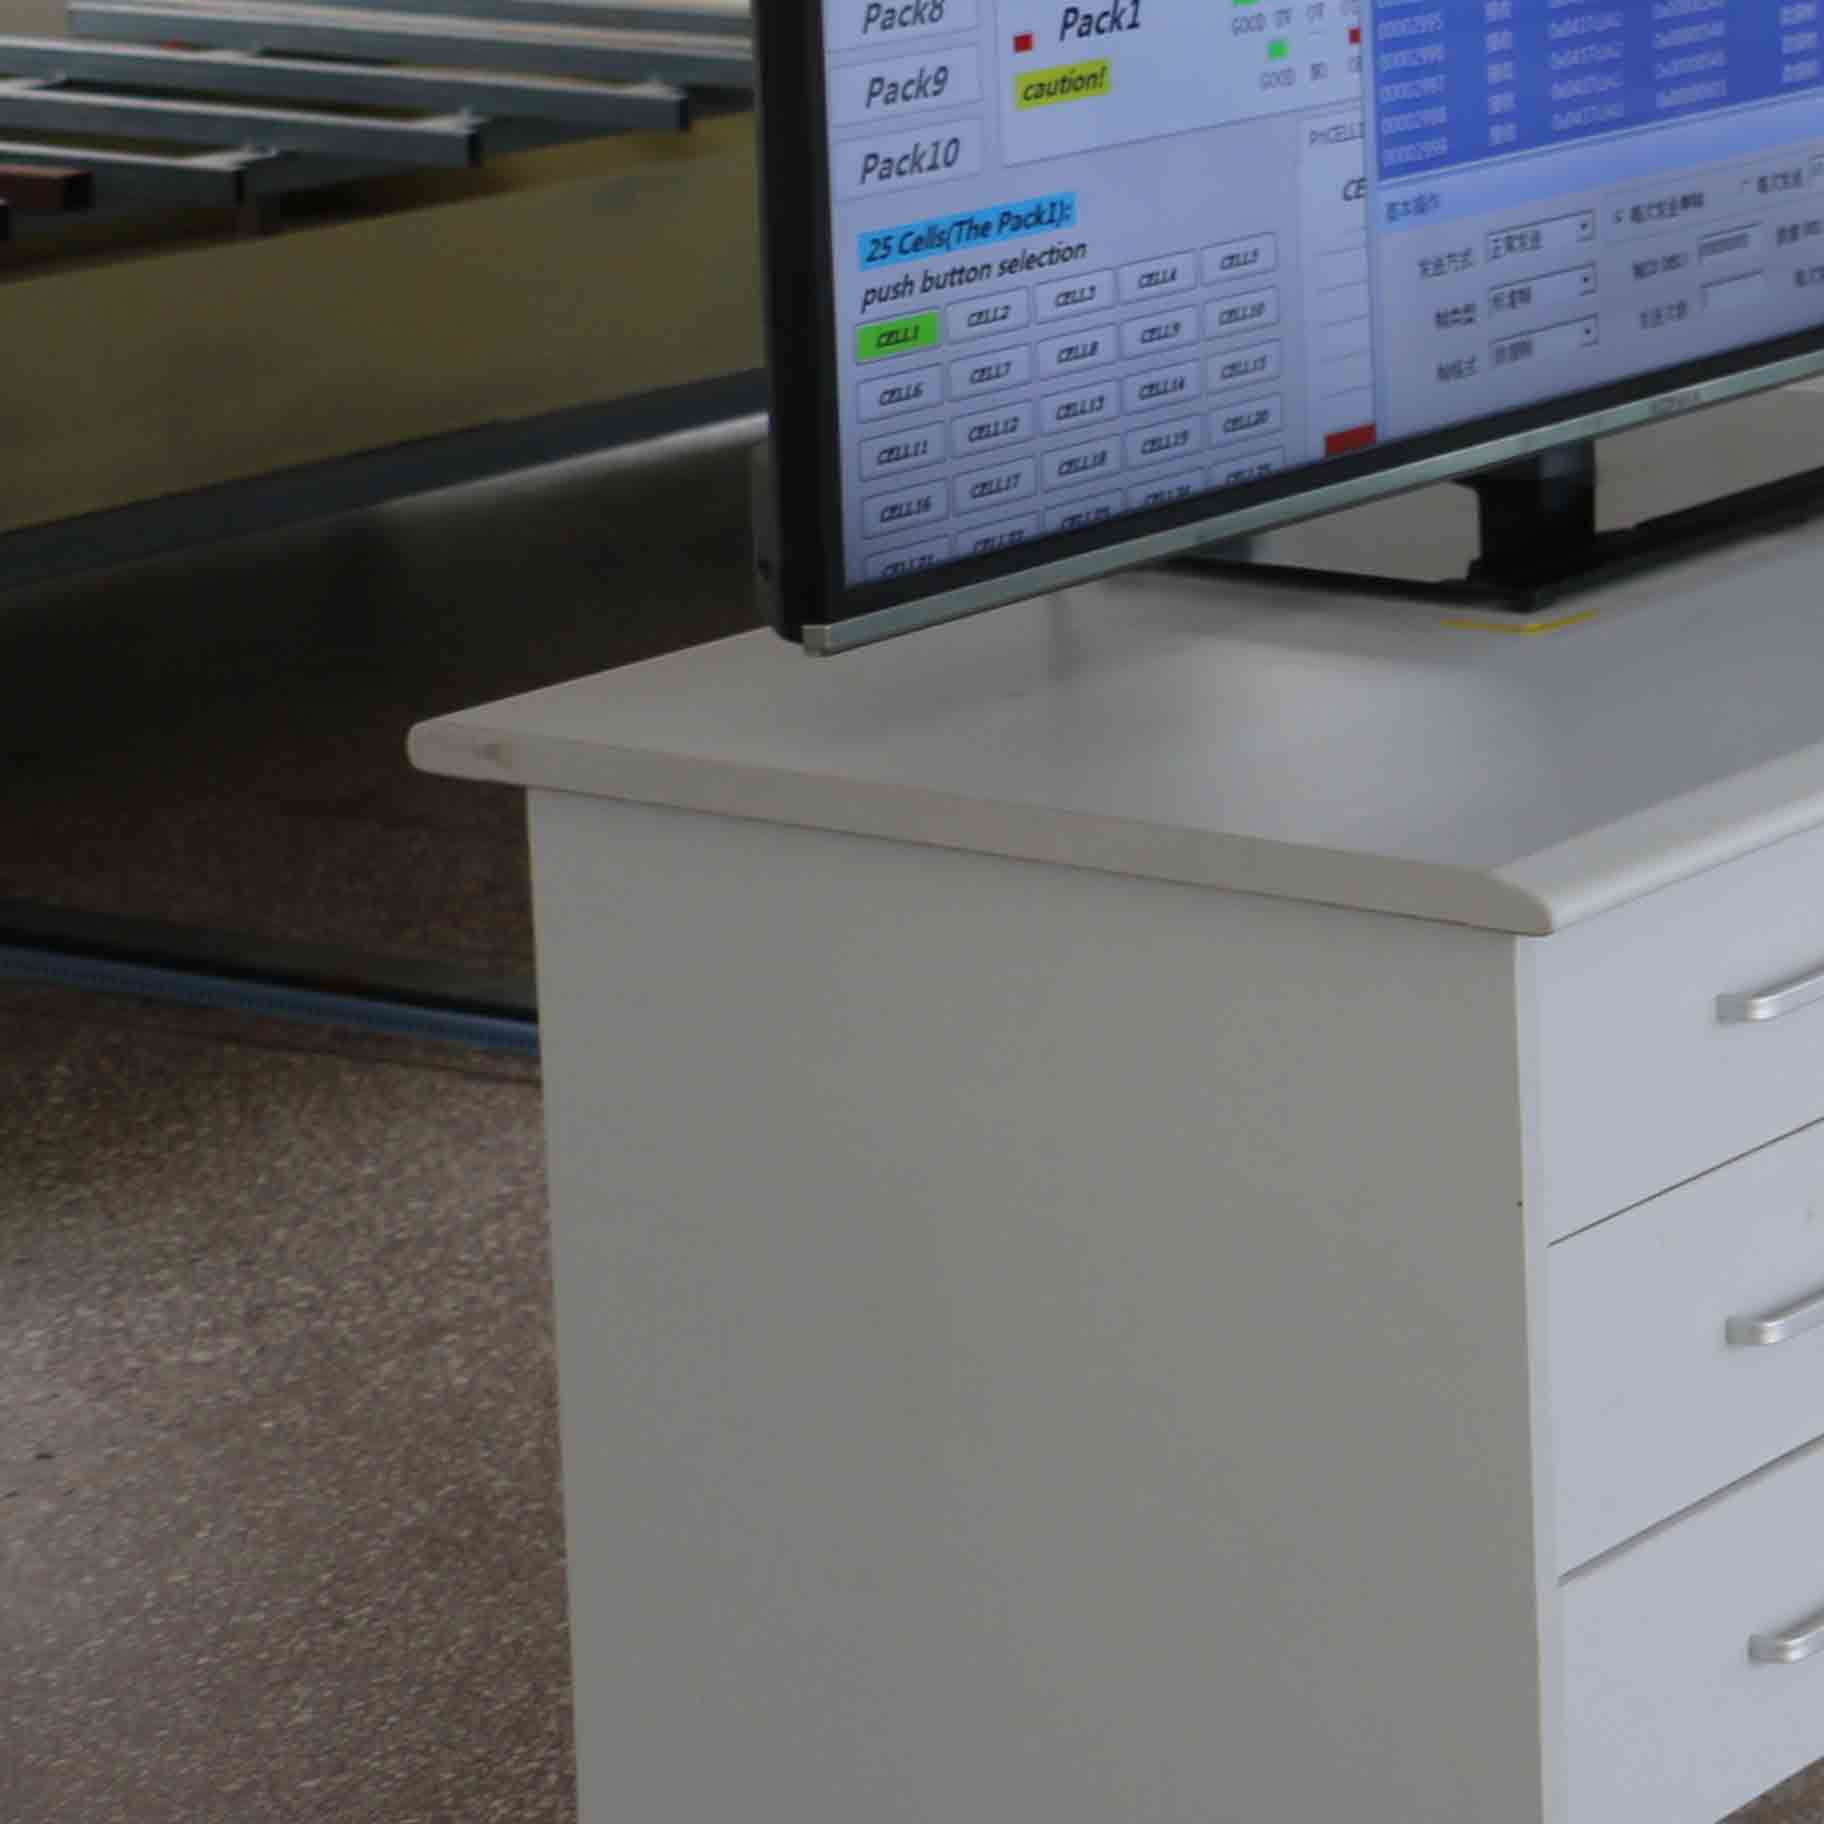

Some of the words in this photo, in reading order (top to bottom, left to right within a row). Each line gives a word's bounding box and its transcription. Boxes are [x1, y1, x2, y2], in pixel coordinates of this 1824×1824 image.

[865, 66, 948, 108] Pack9
[1022, 67, 1108, 103] caution!
[860, 138, 960, 184] Pack10
[865, 237, 895, 263] 25
[898, 216, 993, 255] Cells(The
[861, 275, 915, 313] push
[921, 258, 992, 294] button
[997, 242, 1087, 279] selection
[876, 326, 919, 348] CELL1
[967, 305, 1011, 327] CELL2
